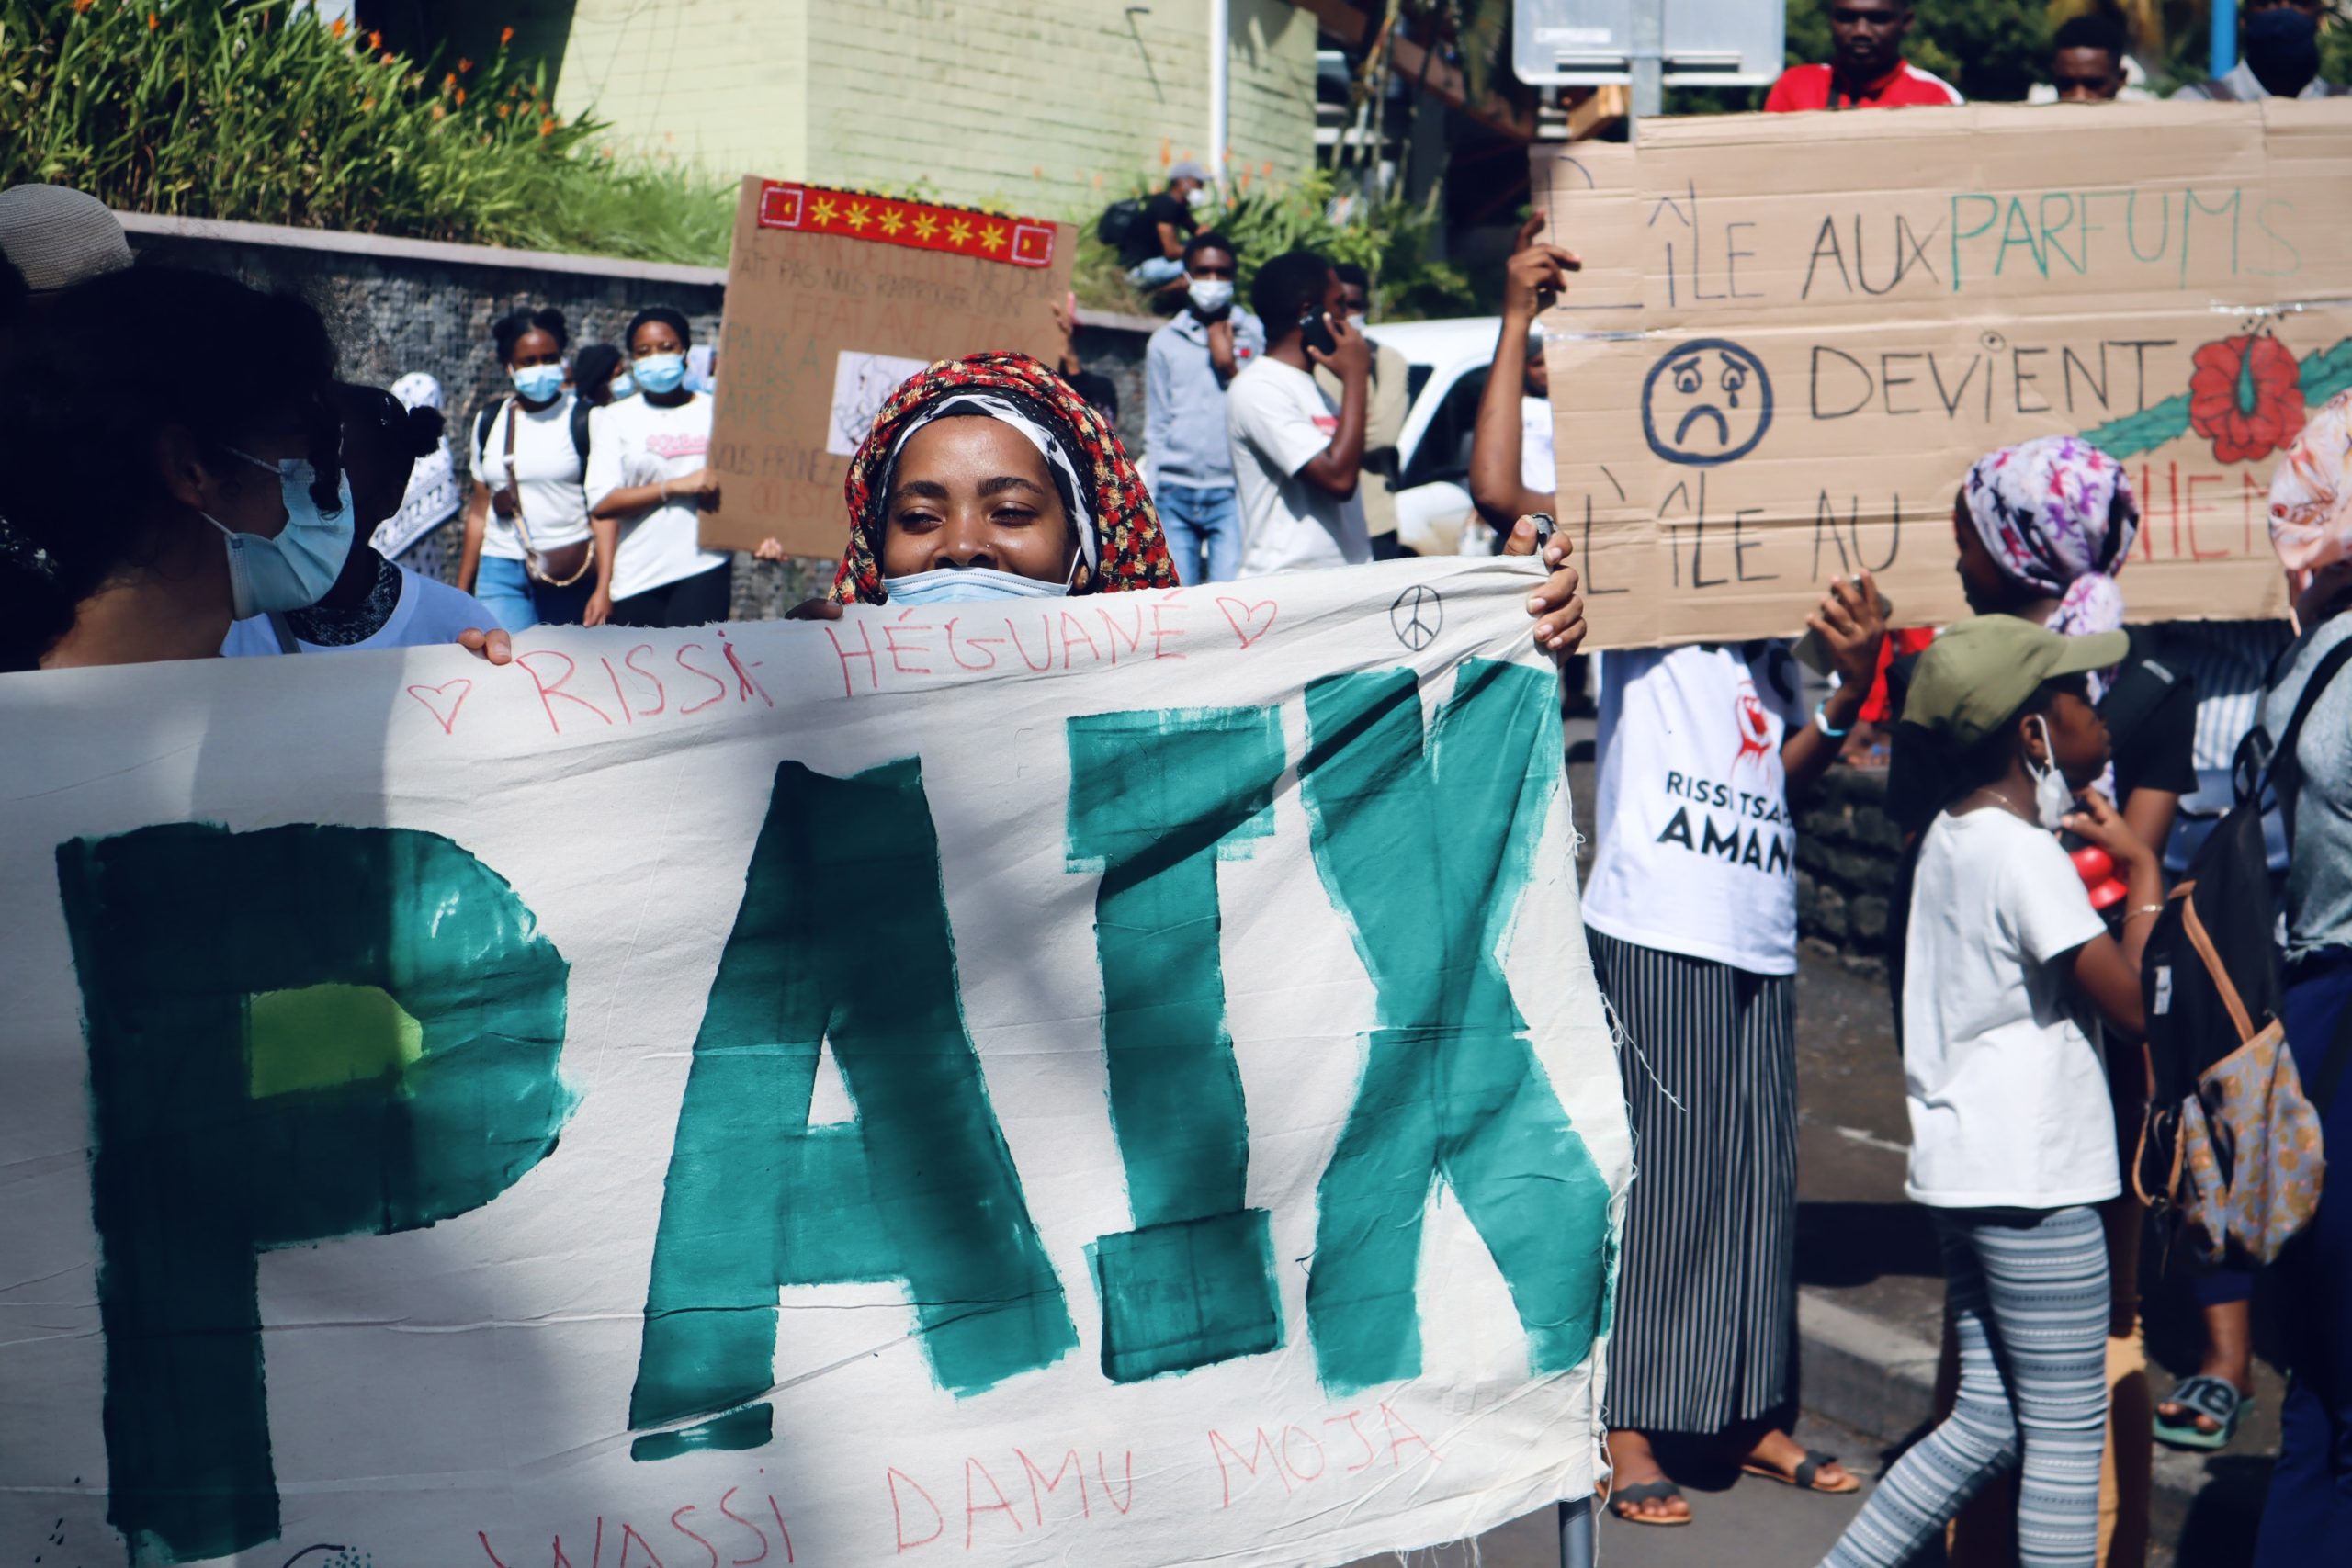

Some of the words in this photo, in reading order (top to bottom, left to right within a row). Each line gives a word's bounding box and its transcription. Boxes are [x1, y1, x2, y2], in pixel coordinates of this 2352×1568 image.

[1802, 213, 1944, 300] AUX
[1951, 186, 2302, 291] PARFUMS
[1813, 489, 1900, 582] AU
[825, 589, 1189, 697] HÉGUANÉ
[1667, 771, 1734, 810] RISSI
[52, 658, 1623, 1568] PAIX
[887, 1447, 1133, 1555] DAMU
[1207, 1402, 1443, 1509] MOJA
